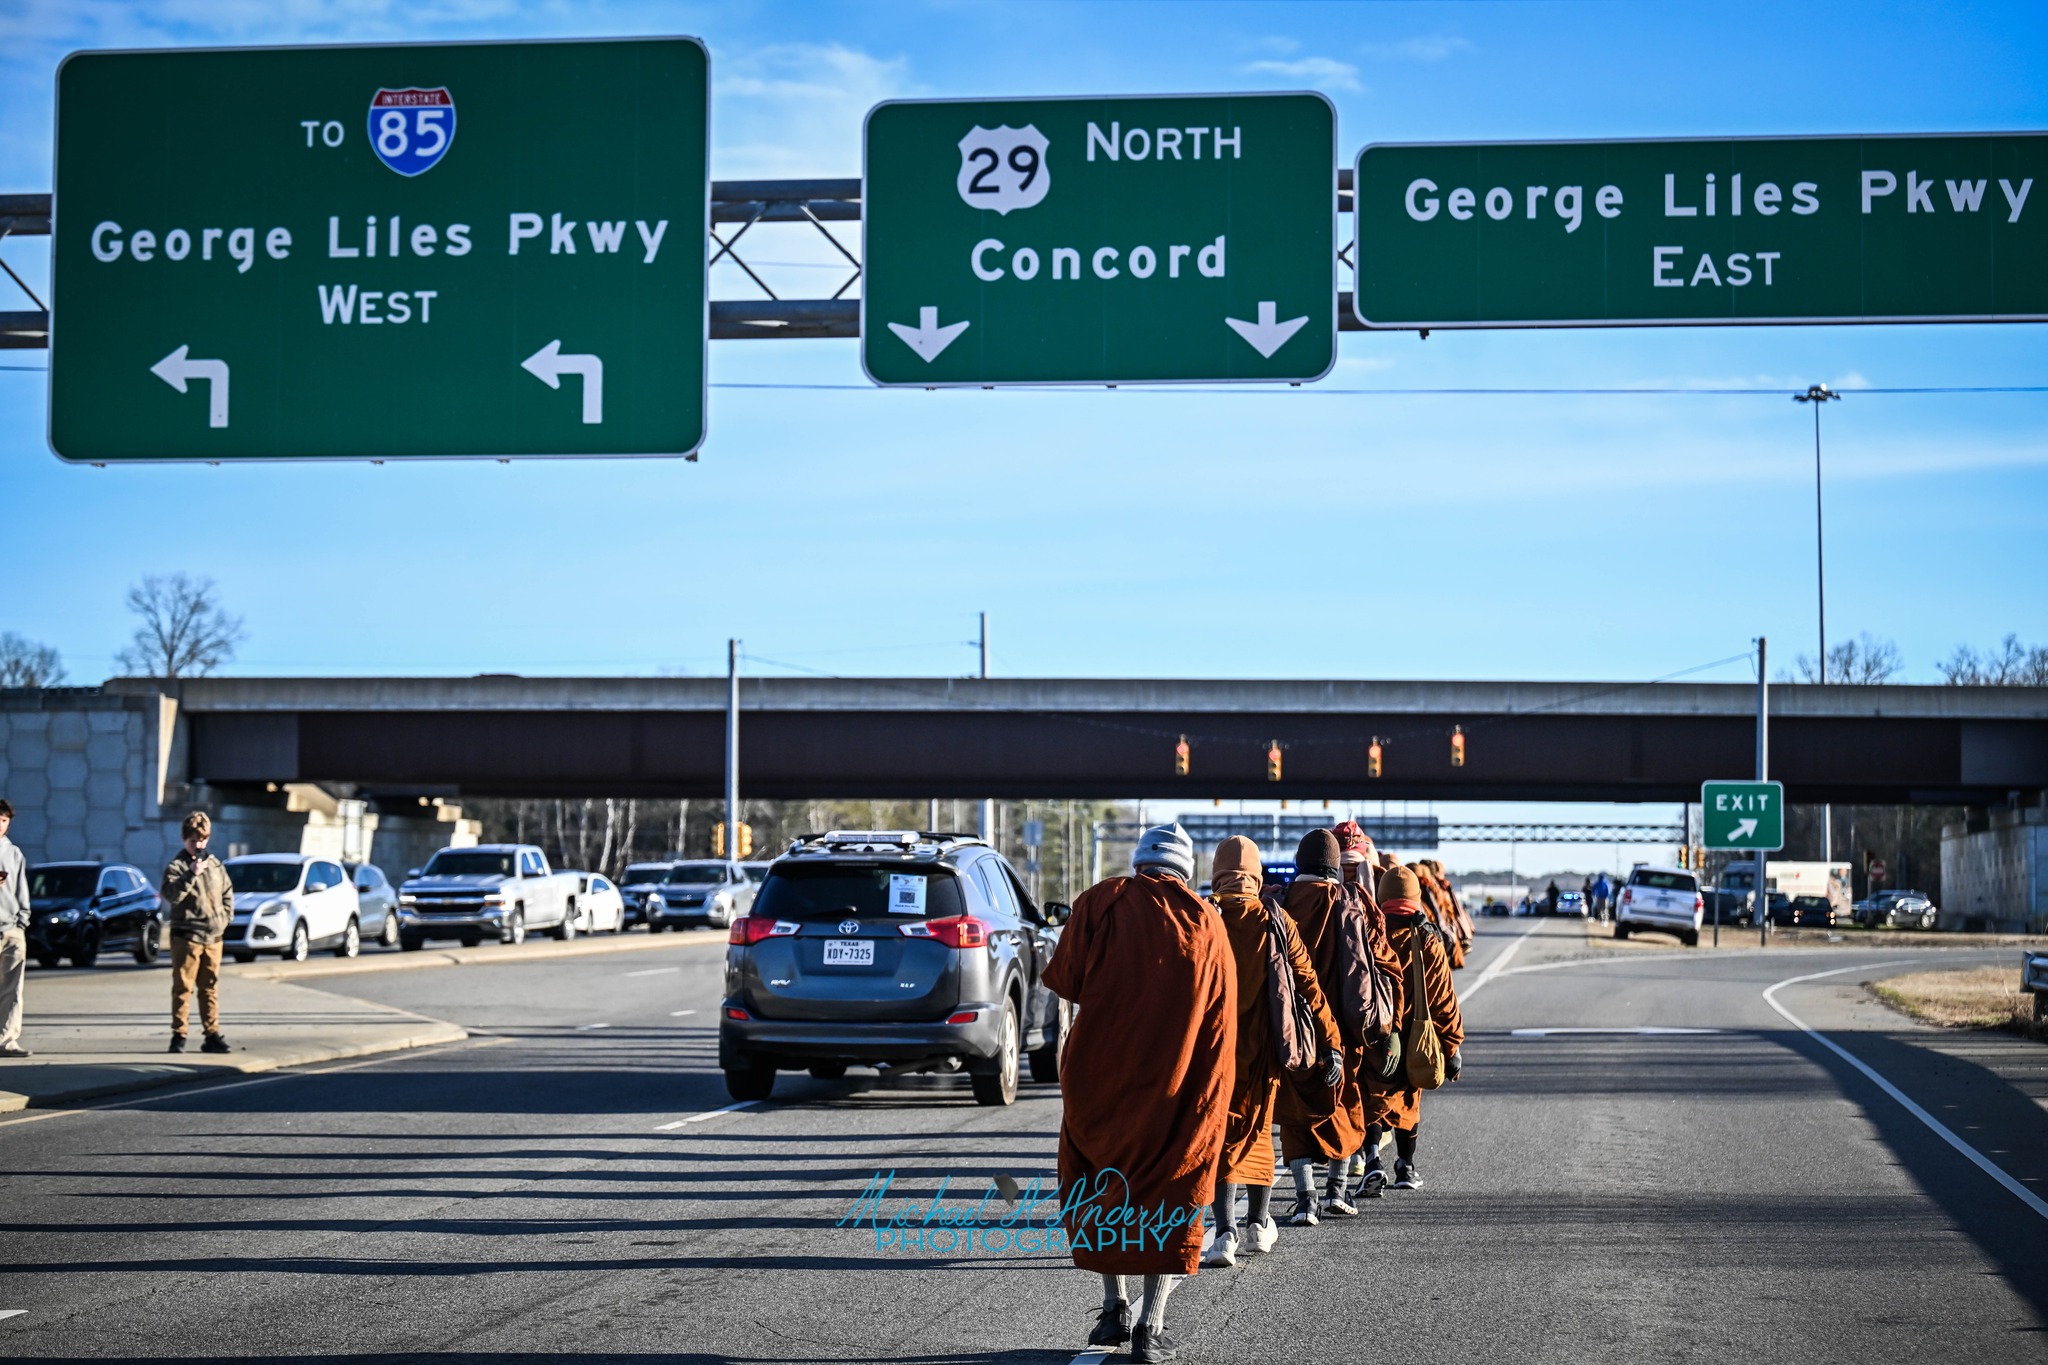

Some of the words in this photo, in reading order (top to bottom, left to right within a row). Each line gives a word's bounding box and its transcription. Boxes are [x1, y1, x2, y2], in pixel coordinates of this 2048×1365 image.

[382, 93, 441, 105] INTERSTATE
[302, 121, 343, 147] TO
[377, 110, 447, 158] 85
[968, 145, 1040, 195] 29
[1087, 121, 1242, 161] NORTH
[1404, 178, 1624, 233] George
[1664, 173, 1820, 216] Liles
[1861, 170, 2033, 223] Pkwy
[91, 221, 292, 273] George
[329, 215, 472, 258] Liles
[508, 212, 668, 263] Pkwy
[970, 235, 1226, 281] Concord
[1653, 246, 1781, 287] EAST
[319, 284, 437, 324] WEST
[1716, 794, 1768, 811] EXIT
